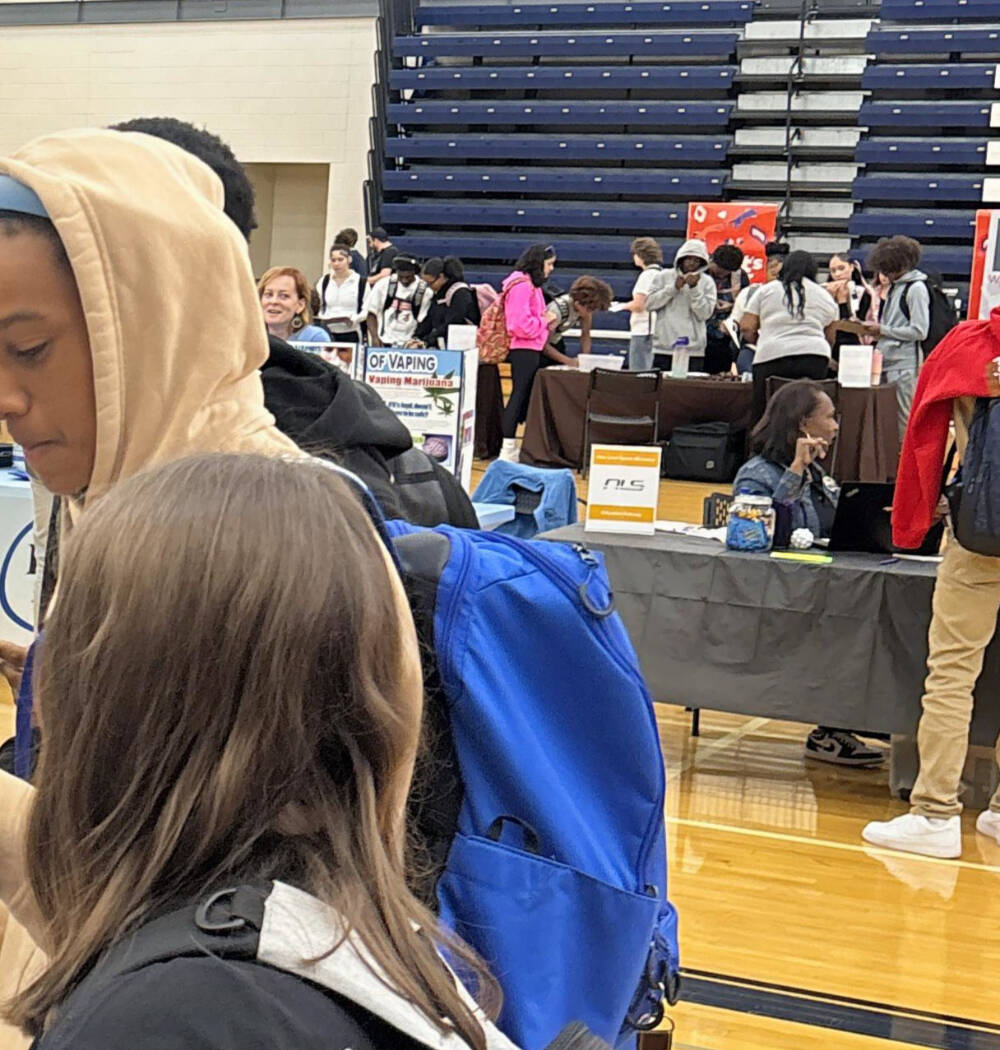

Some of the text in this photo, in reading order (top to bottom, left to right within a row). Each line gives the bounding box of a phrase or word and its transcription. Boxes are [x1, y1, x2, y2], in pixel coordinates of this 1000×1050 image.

[369, 354, 436, 371] OF VAPING
[369, 375, 454, 388] Vaping Marijuana
